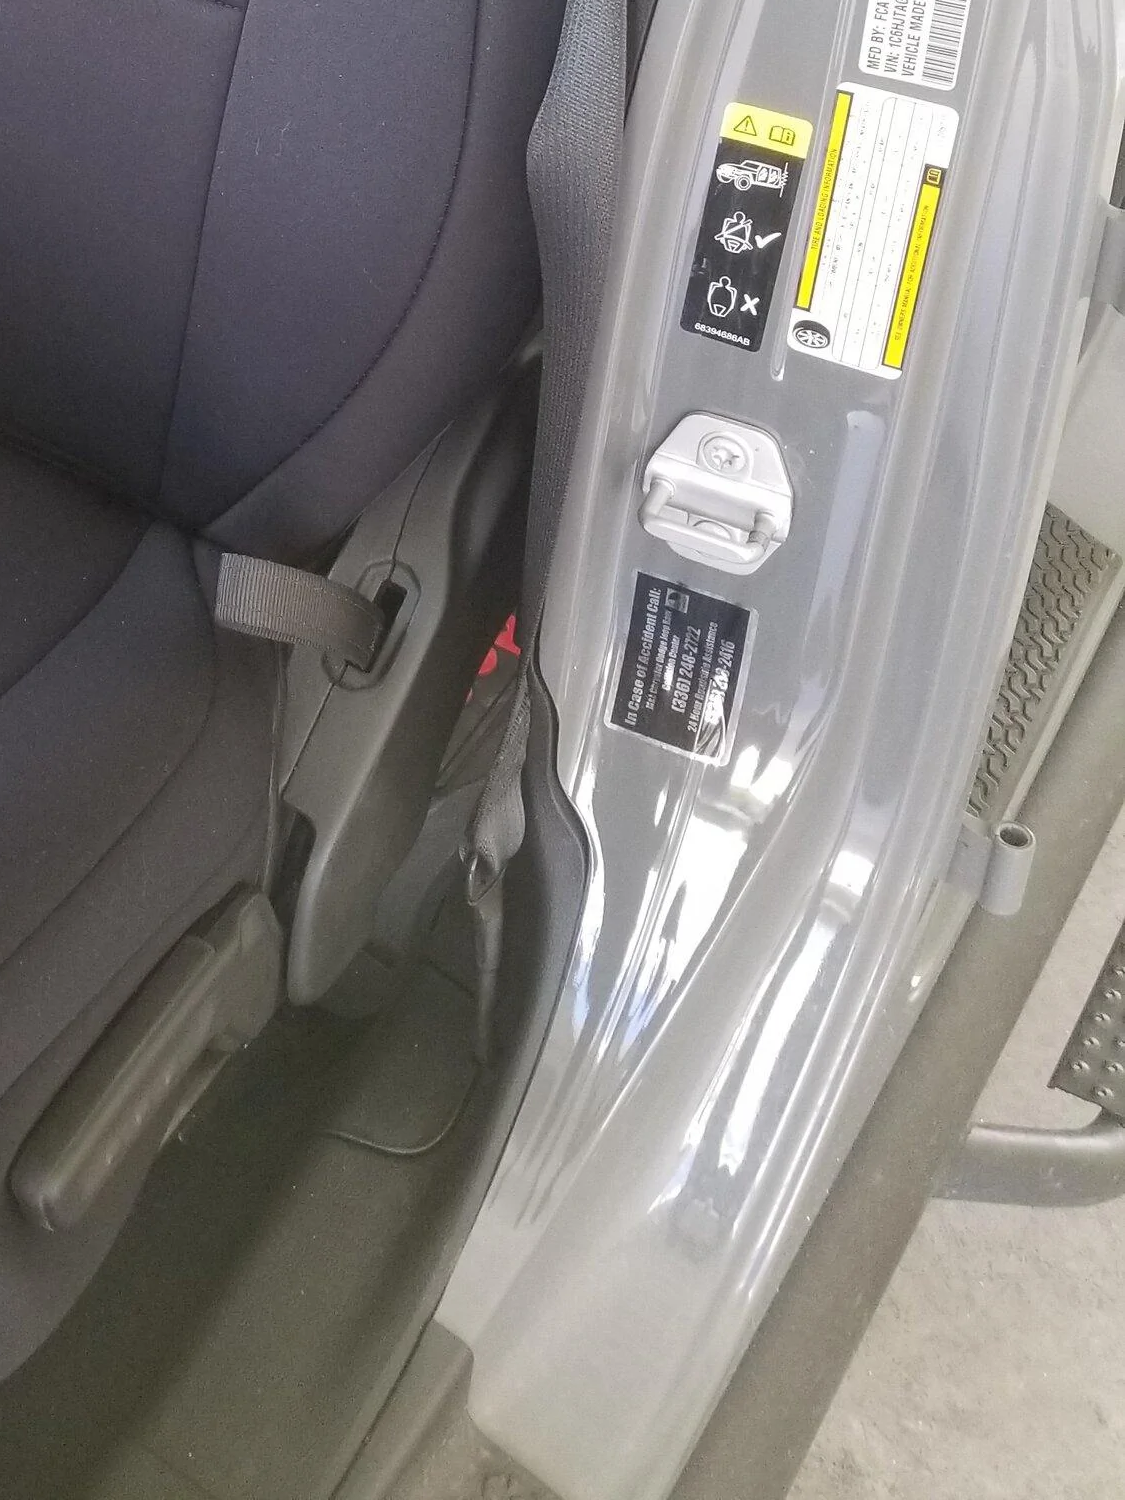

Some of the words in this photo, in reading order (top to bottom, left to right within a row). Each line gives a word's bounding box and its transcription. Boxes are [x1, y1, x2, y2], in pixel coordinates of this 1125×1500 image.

[874, 0, 889, 21] FCA
[909, 0, 926, 31] MADE
[870, 25, 885, 43] BY:
[866, 45, 882, 69] MFD
[884, 51, 899, 73] VIN:
[901, 34, 920, 77] VEHICLE
[645, 586, 662, 613] Call:
[636, 613, 658, 664] Accident
[634, 663, 647, 678] of
[627, 678, 645, 711] Case
[624, 711, 637, 725] In
